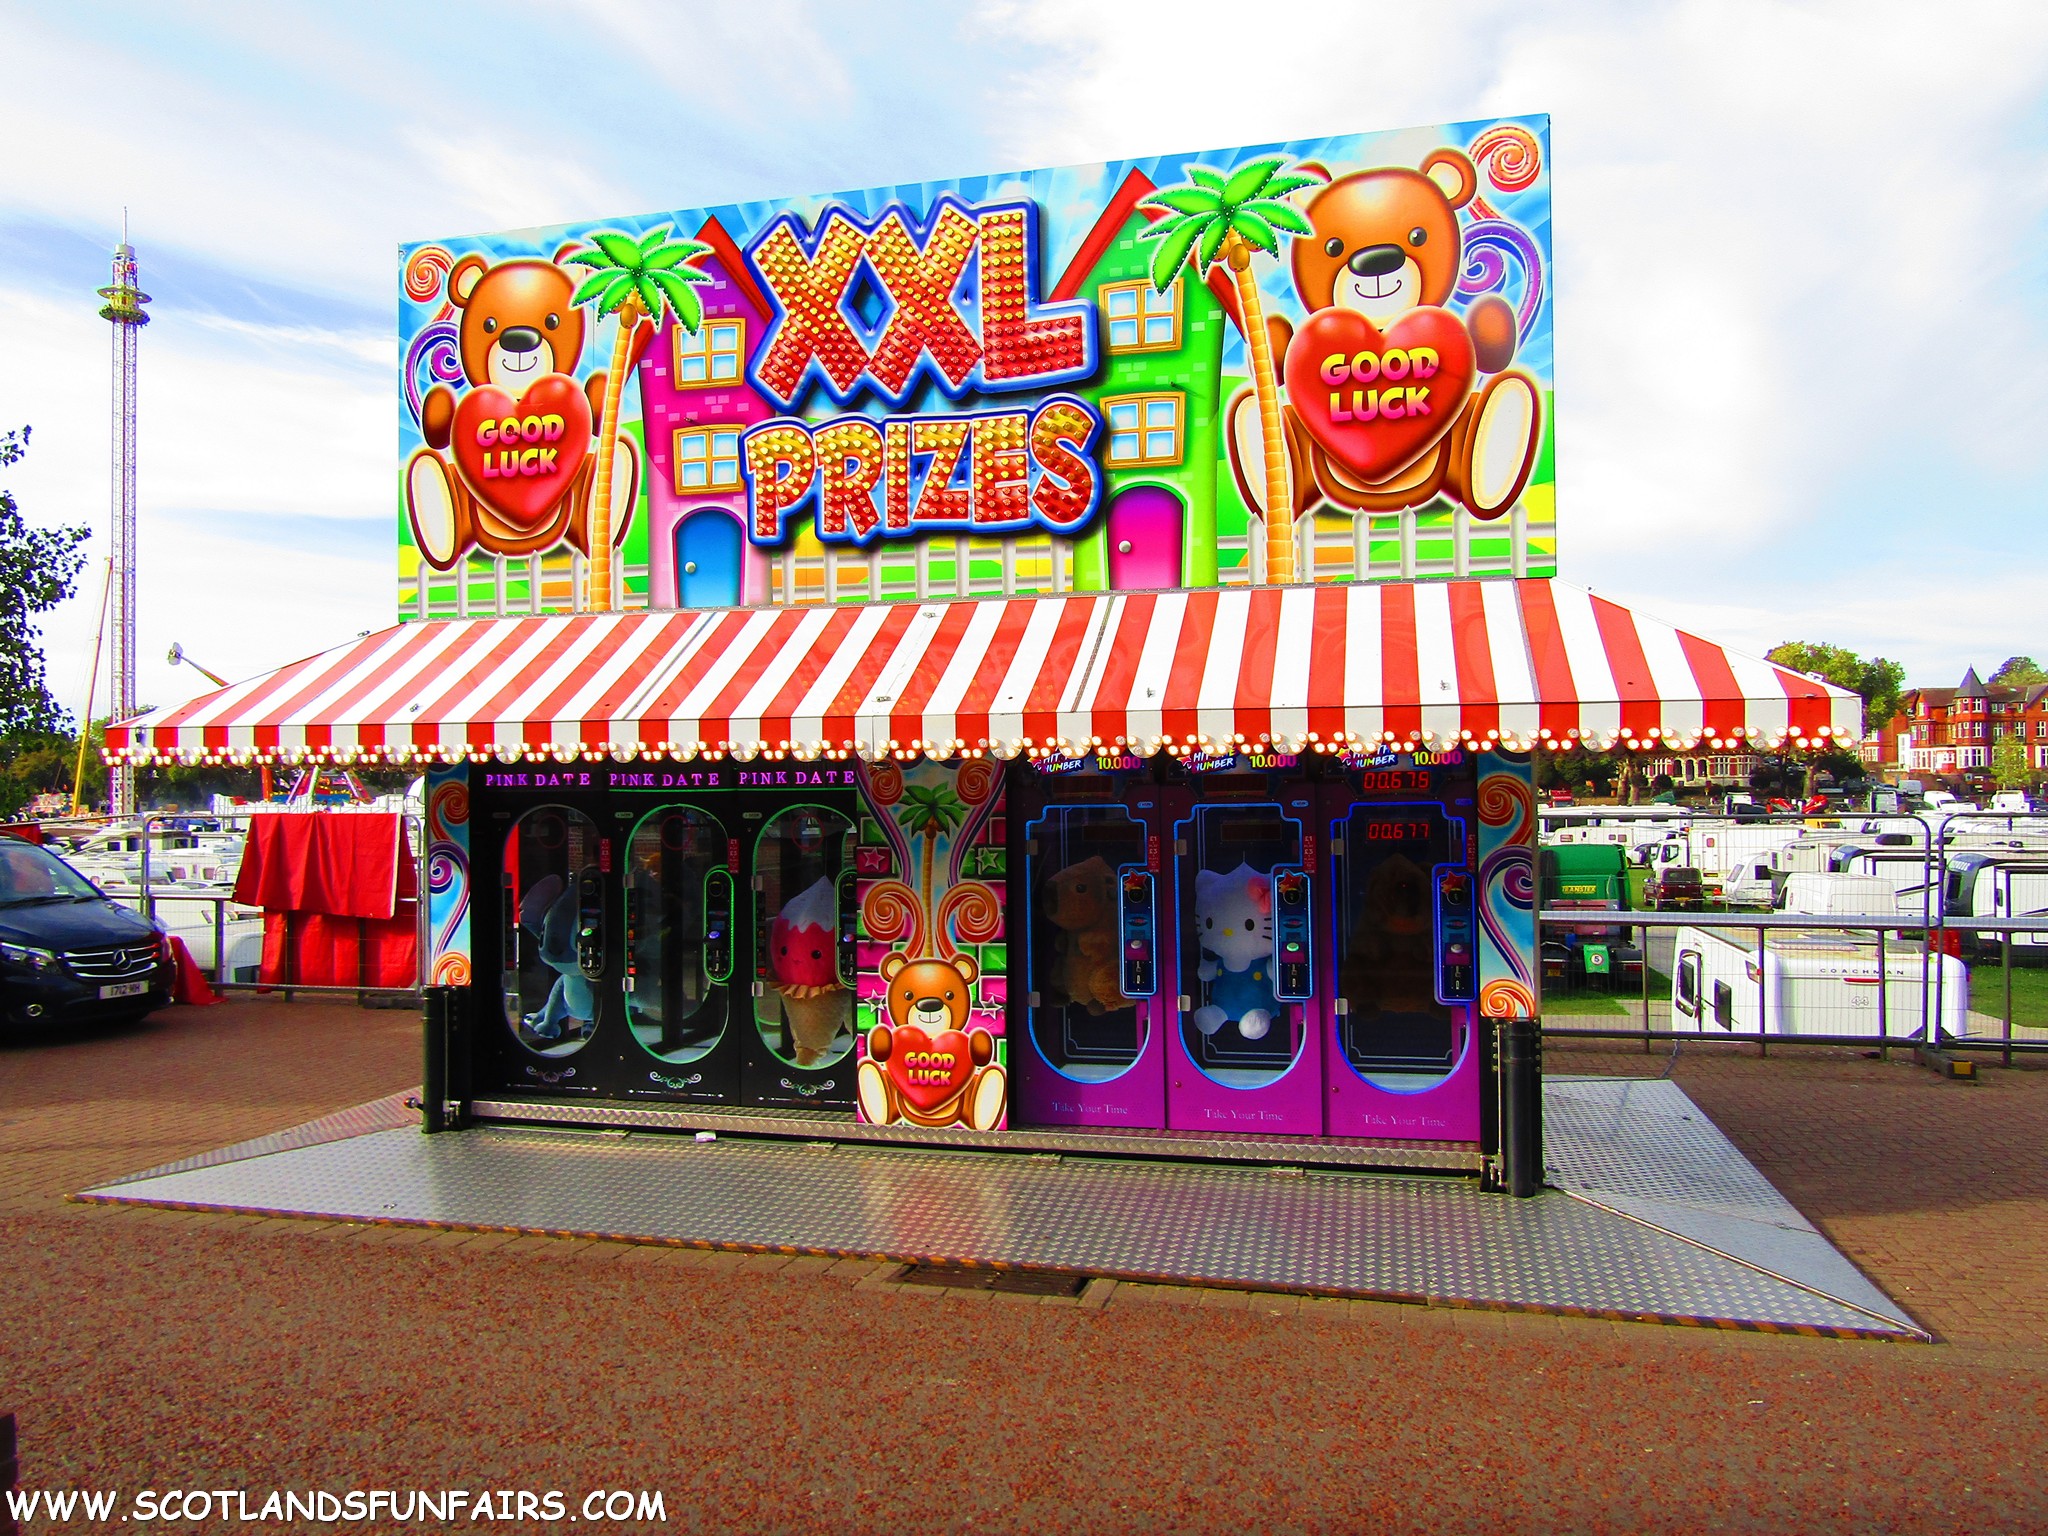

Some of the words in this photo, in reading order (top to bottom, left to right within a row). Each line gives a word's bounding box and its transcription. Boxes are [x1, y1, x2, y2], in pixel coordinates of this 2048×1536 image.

[748, 202, 1092, 406] XXL
[1320, 347, 1440, 386] GOOD
[1329, 386, 1432, 422] LUCK
[476, 414, 565, 447] GOOD
[482, 448, 558, 479] LUCK
[743, 400, 1099, 539] PRIZES
[1096, 756, 1141, 770] 10.000
[1249, 754, 1297, 768] 10.000
[1412, 750, 1463, 765] 10.000
[485, 773, 529, 787] PINK
[535, 772, 591, 786] DATE
[609, 773, 655, 787] PINK
[661, 772, 720, 787] DATE
[738, 771, 787, 786] PINK
[795, 770, 855, 785] DATE
[904, 1051, 956, 1069] GOOD
[908, 1069, 951, 1086] LUCK
[1051, 1101, 1074, 1113] Take
[1078, 1102, 1101, 1113] Your
[1104, 1103, 1128, 1115] Time
[1204, 1108, 1227, 1119] Take
[1230, 1109, 1255, 1120] Your
[1258, 1110, 1284, 1121] Time
[1362, 1113, 1387, 1125] Take
[1390, 1115, 1417, 1126] Your
[1419, 1116, 1446, 1127] Time
